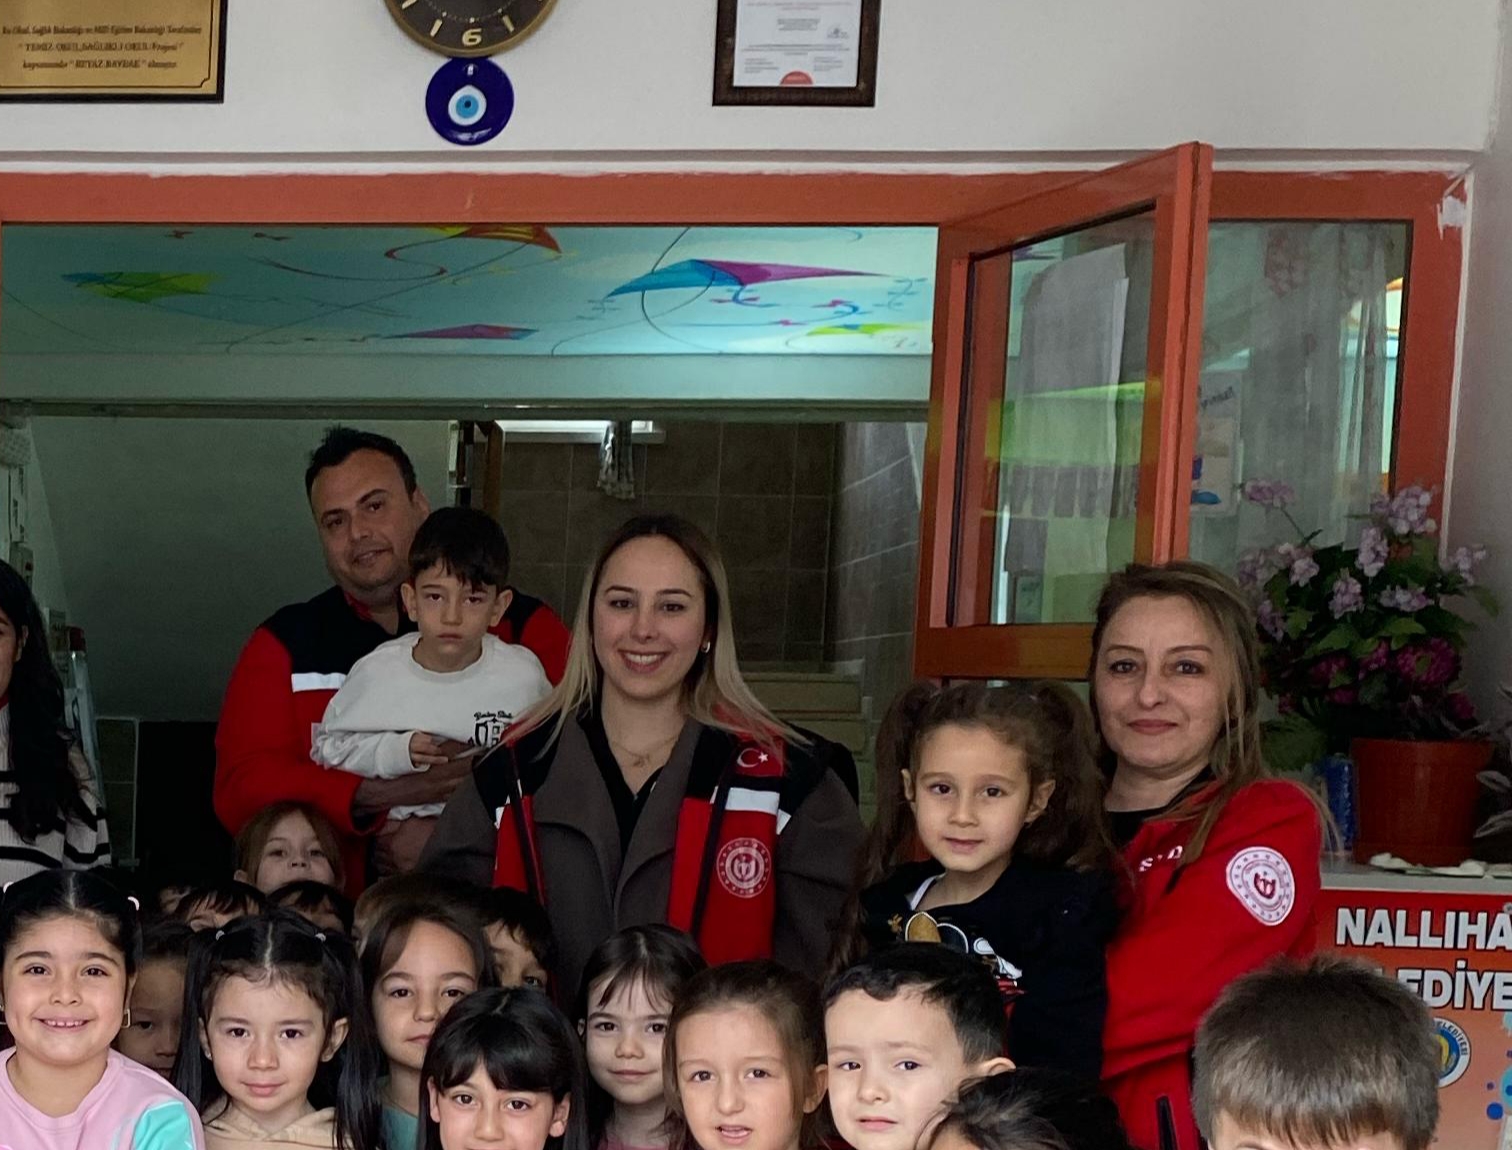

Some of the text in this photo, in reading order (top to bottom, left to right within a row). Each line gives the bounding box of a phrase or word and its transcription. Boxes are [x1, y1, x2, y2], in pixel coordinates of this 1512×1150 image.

[462, 28, 482, 46] 6
[1336, 907, 1512, 951] NALLIHA
[1396, 959, 1512, 1010] EDİYE
